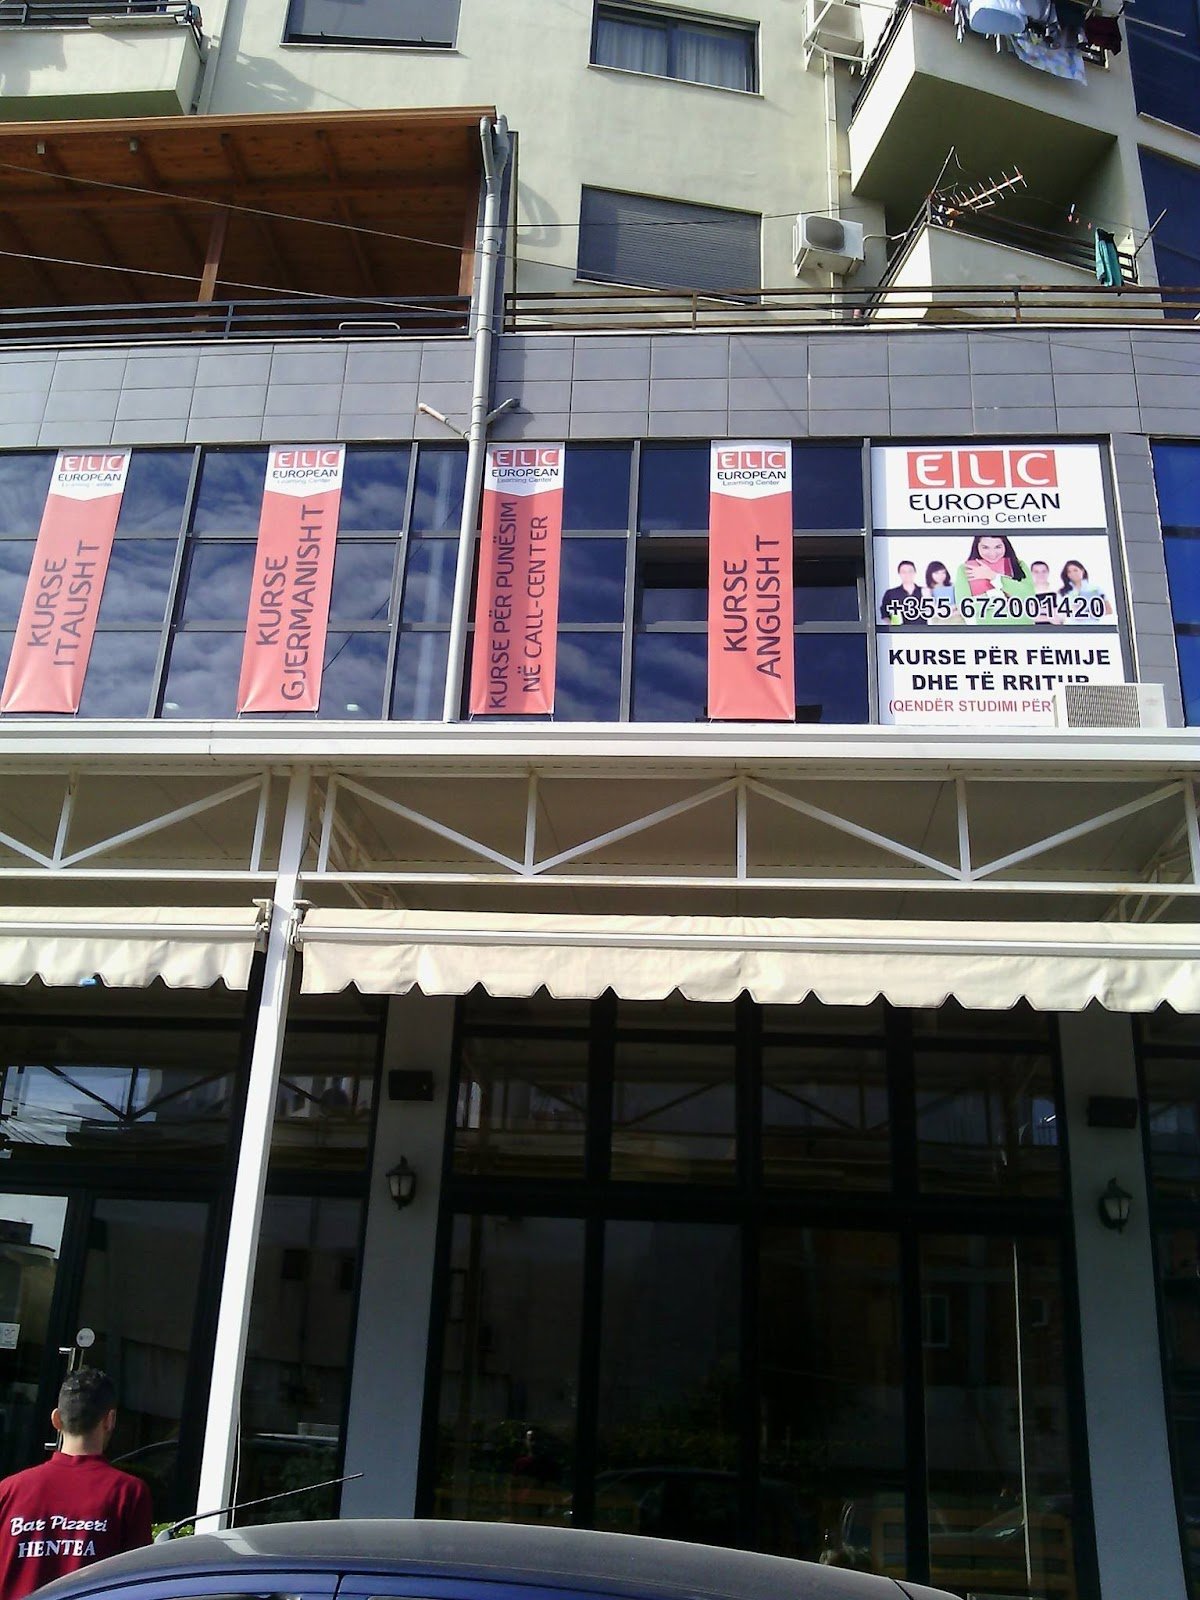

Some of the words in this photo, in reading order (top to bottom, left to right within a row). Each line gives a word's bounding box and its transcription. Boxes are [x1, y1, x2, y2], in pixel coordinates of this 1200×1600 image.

[64, 455, 122, 471] ELC
[278, 451, 338, 467] ELC
[496, 450, 557, 466] ELC
[720, 452, 783, 469] ELC
[58, 472, 122, 482] EUROPEAN
[272, 469, 338, 479] EUROPEAN
[491, 468, 559, 478] EUROPEAN
[717, 470, 787, 480] EUROPEAN
[915, 452, 1050, 486] ELC
[909, 492, 1061, 511] EUROPEAN
[923, 512, 990, 525] Learning
[995, 511, 1047, 523] Center
[493, 502, 517, 588] PUNËSIM
[523, 515, 548, 659] CALL-CENTER
[27, 558, 67, 646] KURSE
[256, 555, 288, 645] KURSE
[281, 504, 324, 701] GJERMANISHT
[723, 559, 748, 652] KURSE
[756, 535, 781, 679] ANGLISHT
[886, 597, 951, 618] +355
[960, 597, 1104, 618] 672001420
[489, 594, 512, 633] PËR
[889, 649, 966, 665] KURSE
[974, 646, 1019, 665] PËR
[1027, 646, 1111, 665] FËMIJE
[489, 639, 510, 708] KURSE
[517, 664, 541, 692] NË
[912, 674, 958, 690] DHE
[966, 671, 995, 690] TË
[889, 699, 954, 715] (QENDËR
[959, 700, 1017, 713] STUDIMI
[1022, 699, 1052, 713] PËR
[10, 1517, 46, 1536] Bar
[18, 1540, 96, 1558] HENTEA
